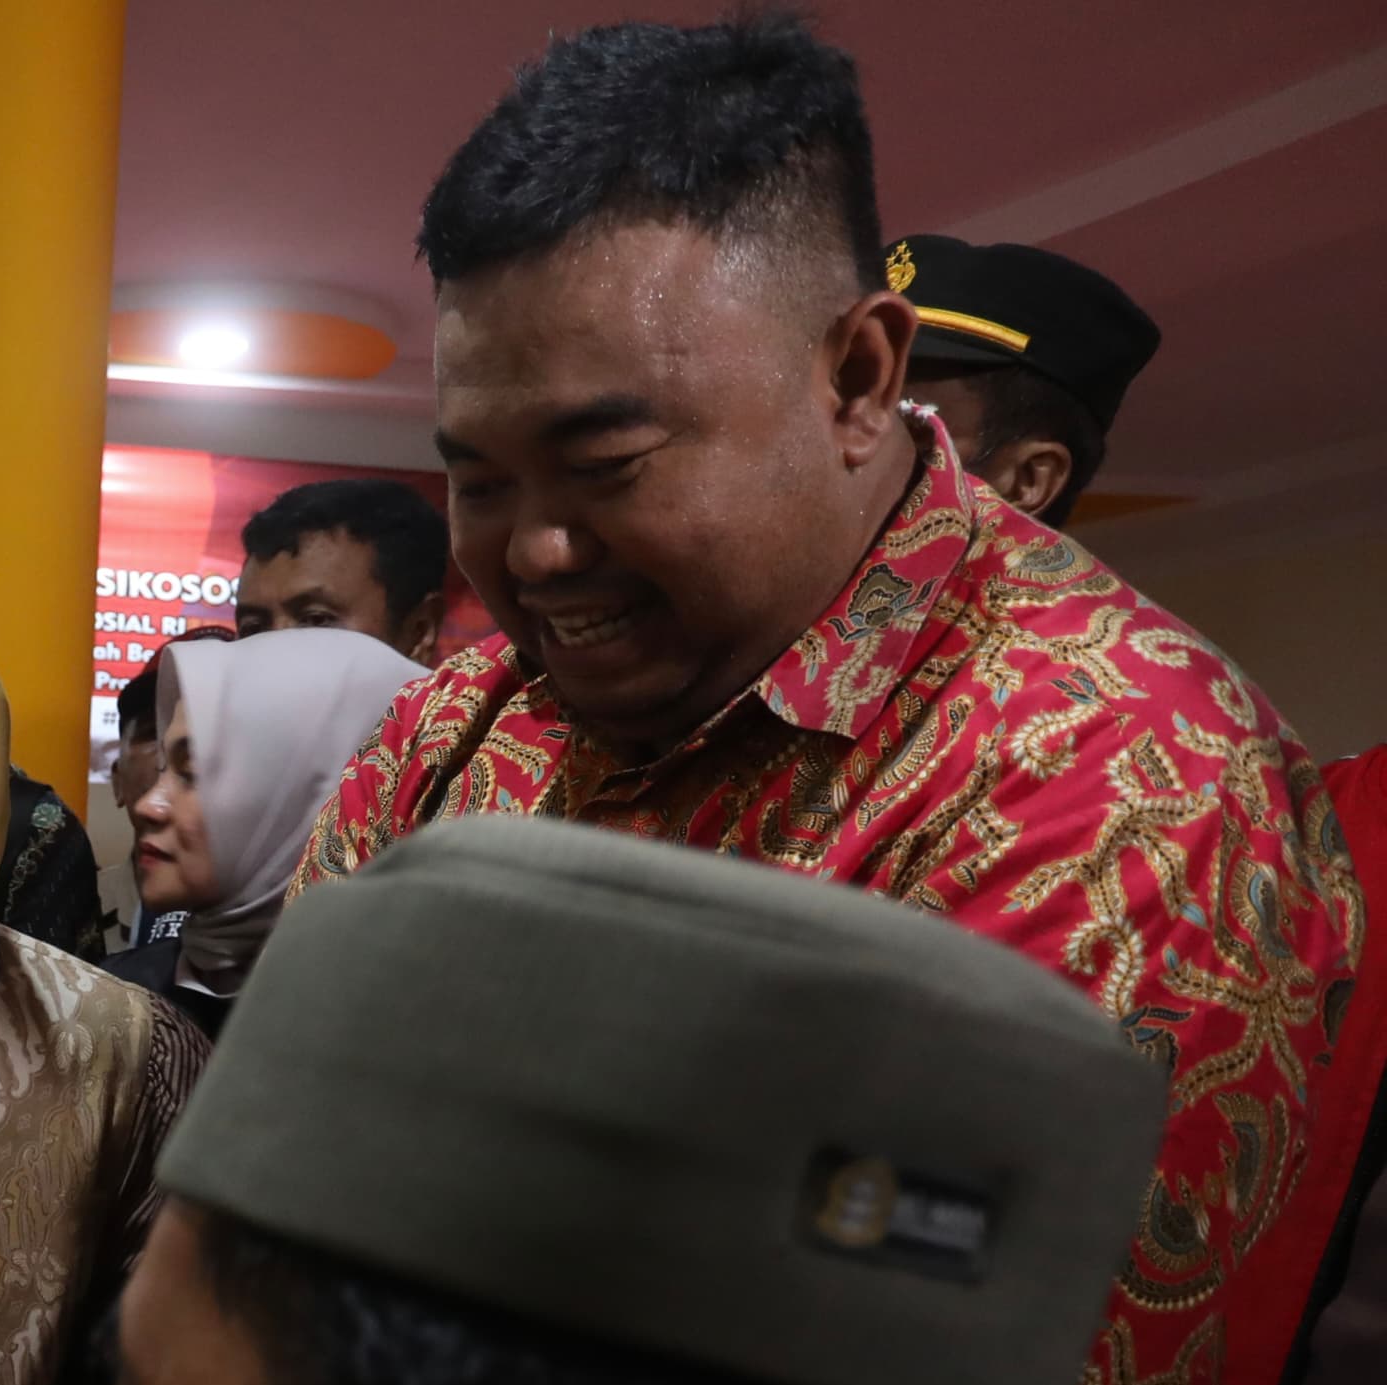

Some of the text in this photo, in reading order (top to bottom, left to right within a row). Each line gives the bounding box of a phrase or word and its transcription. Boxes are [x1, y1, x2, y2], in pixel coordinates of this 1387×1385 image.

[96, 567, 238, 606] SIKOSO
[161, 616, 187, 636] RI
[93, 641, 121, 660] ah
